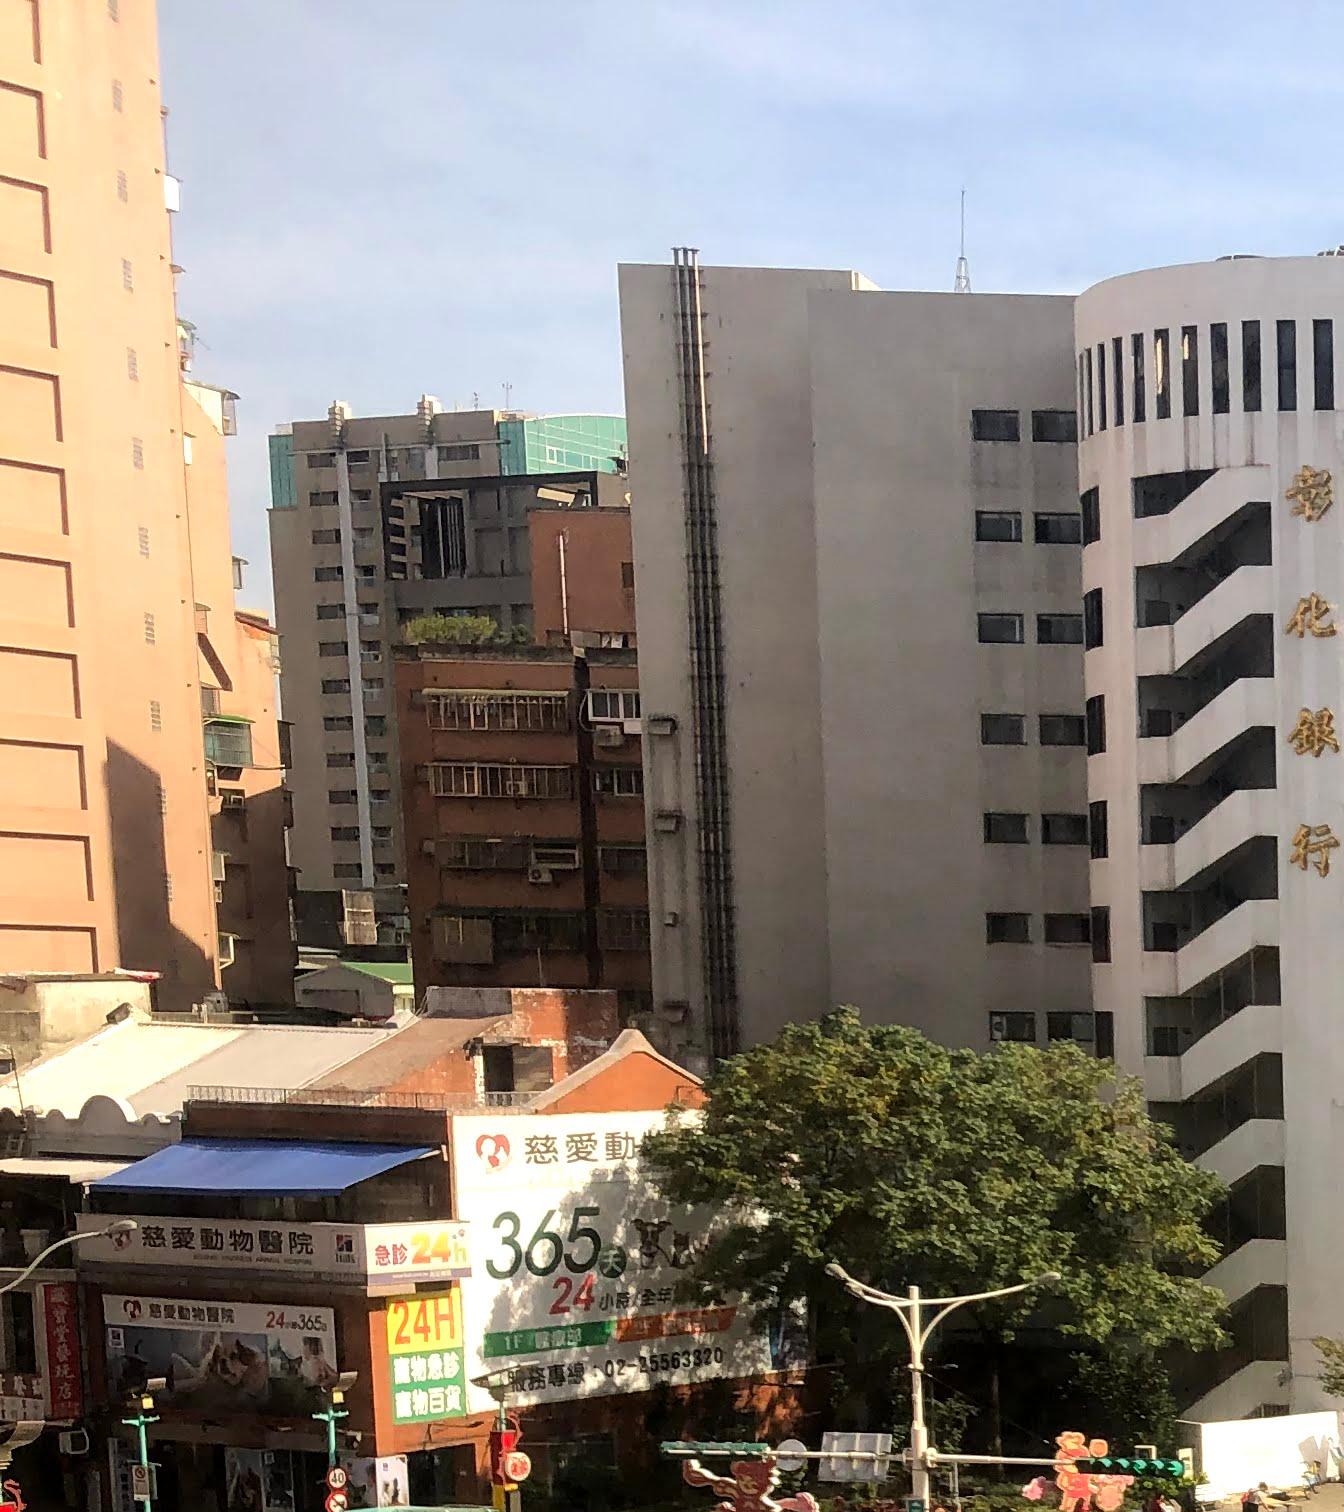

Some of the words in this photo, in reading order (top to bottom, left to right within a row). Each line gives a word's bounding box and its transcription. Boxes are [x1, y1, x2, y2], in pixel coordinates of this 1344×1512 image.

[1284, 464, 1340, 879] 彰化銀行
[141, 1225, 314, 1256] 慈愛動物醫院
[374, 1243, 408, 1267] 急診
[486, 1206, 600, 1280] 365
[550, 1274, 595, 1315] 24
[149, 1303, 235, 1325] 慈愛動物醫院
[394, 1296, 455, 1346] 24H
[393, 1351, 460, 1384] 寵物急診
[395, 1385, 462, 1419] 寵物百貨
[331, 1472, 344, 1484] 40
